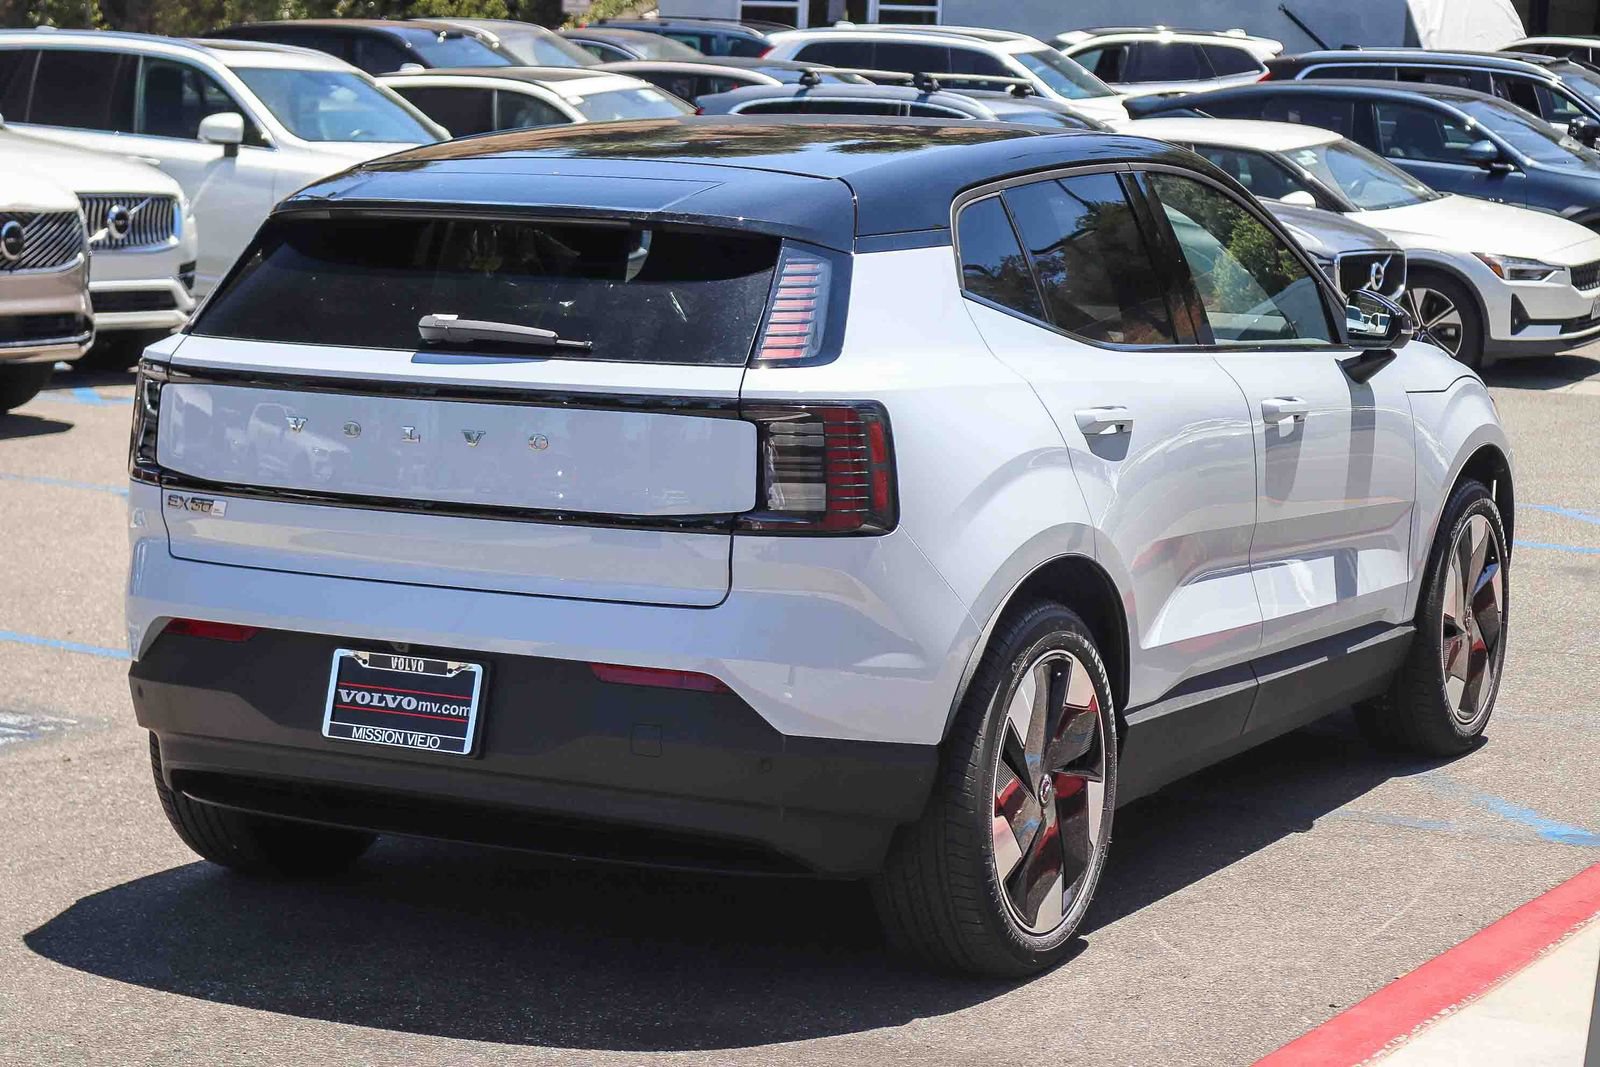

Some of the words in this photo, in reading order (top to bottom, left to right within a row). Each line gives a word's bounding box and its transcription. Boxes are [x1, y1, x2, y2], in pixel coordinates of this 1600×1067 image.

[286, 415, 550, 450] VOLVO
[391, 656, 424, 672] VOLVO
[338, 688, 471, 717] VOLVOmv.com
[352, 726, 404, 744] MISSION
[407, 732, 440, 749] VIEJO
